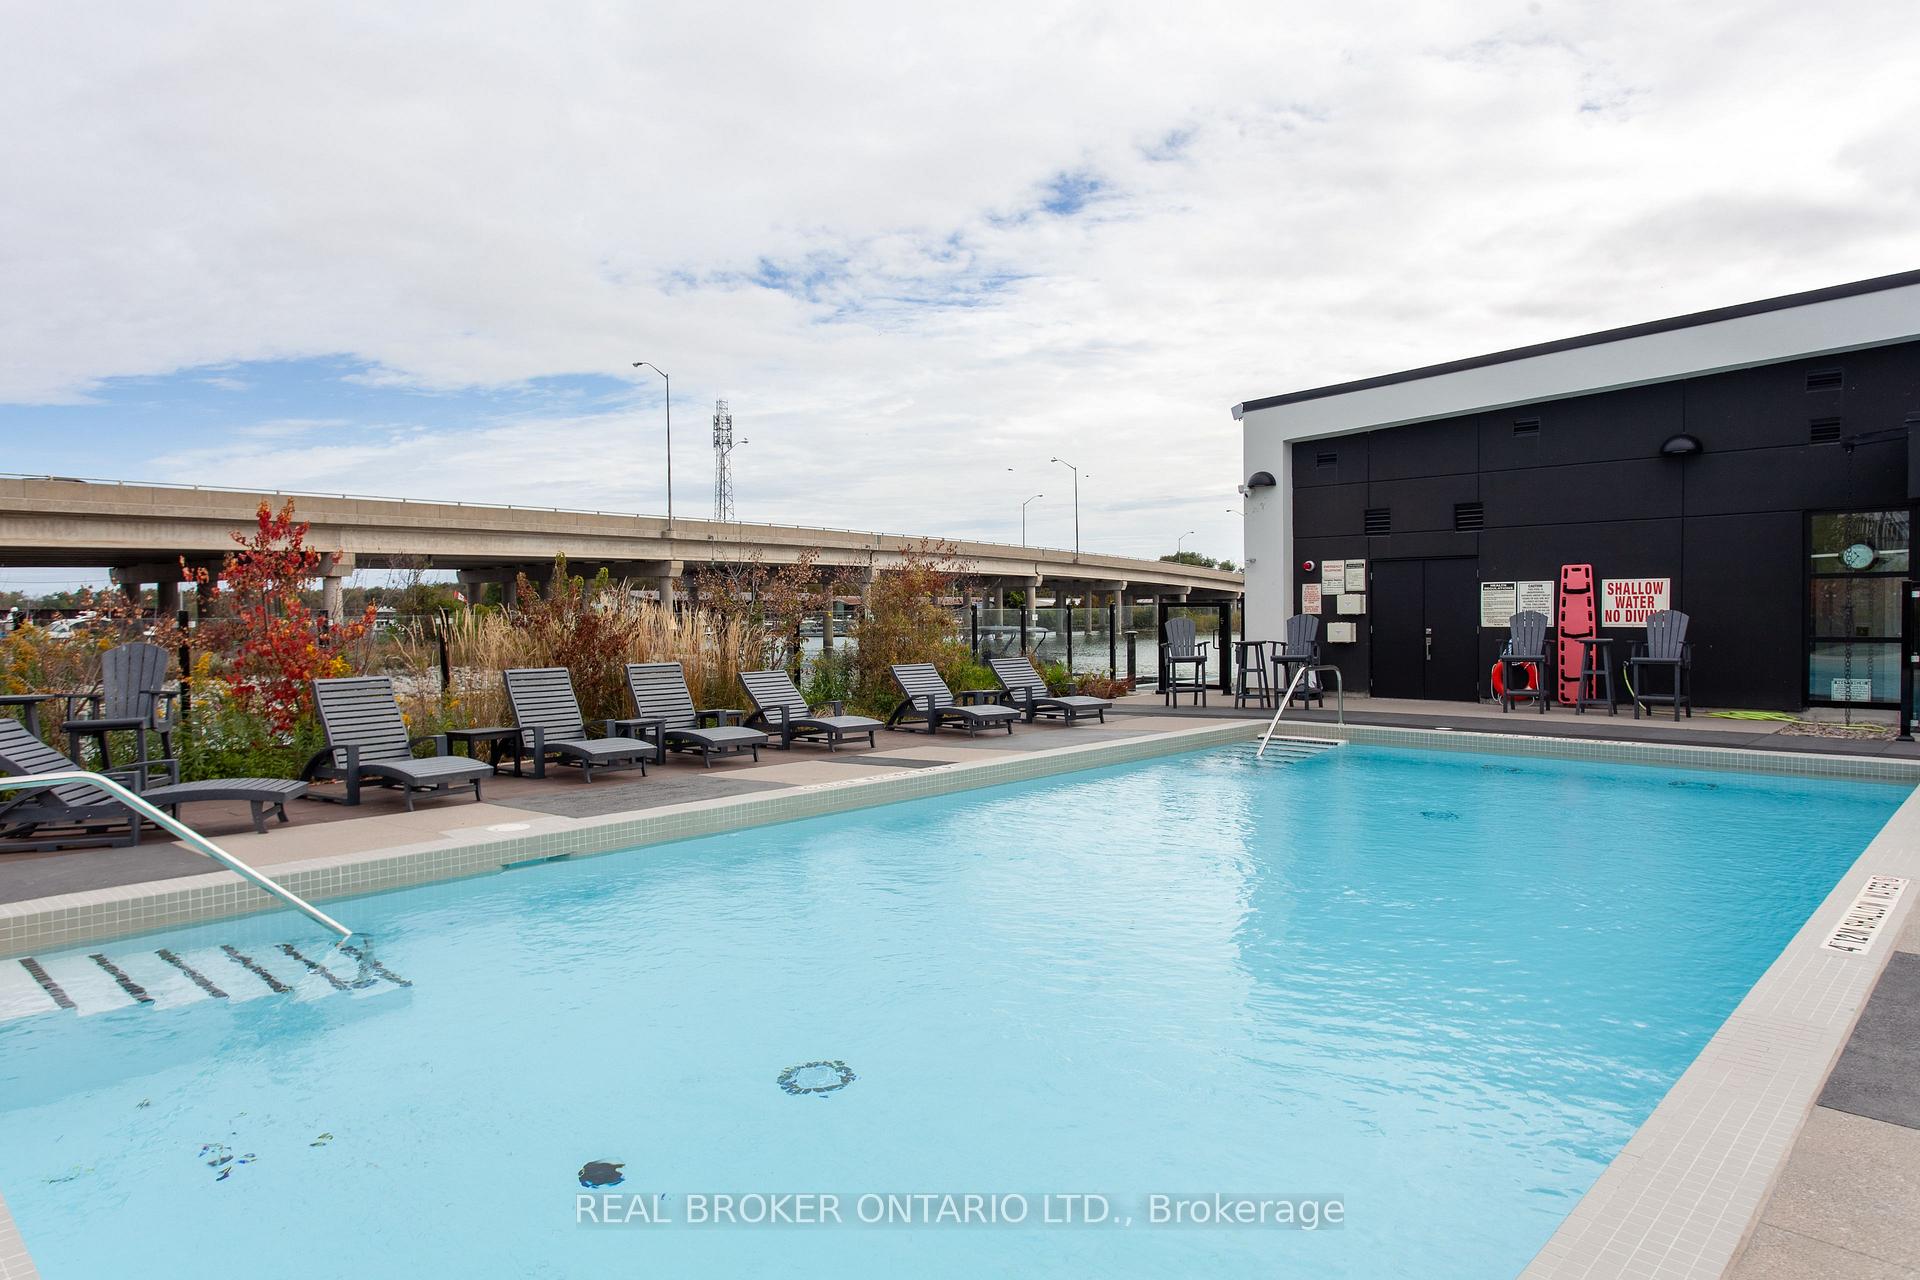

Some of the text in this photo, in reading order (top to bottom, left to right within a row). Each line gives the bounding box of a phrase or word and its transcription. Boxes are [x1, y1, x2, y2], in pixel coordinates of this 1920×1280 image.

[1607, 582, 1664, 595] SHALLOW
[1615, 596, 1655, 608] WATER
[1605, 609, 1663, 623] NO DIVI
